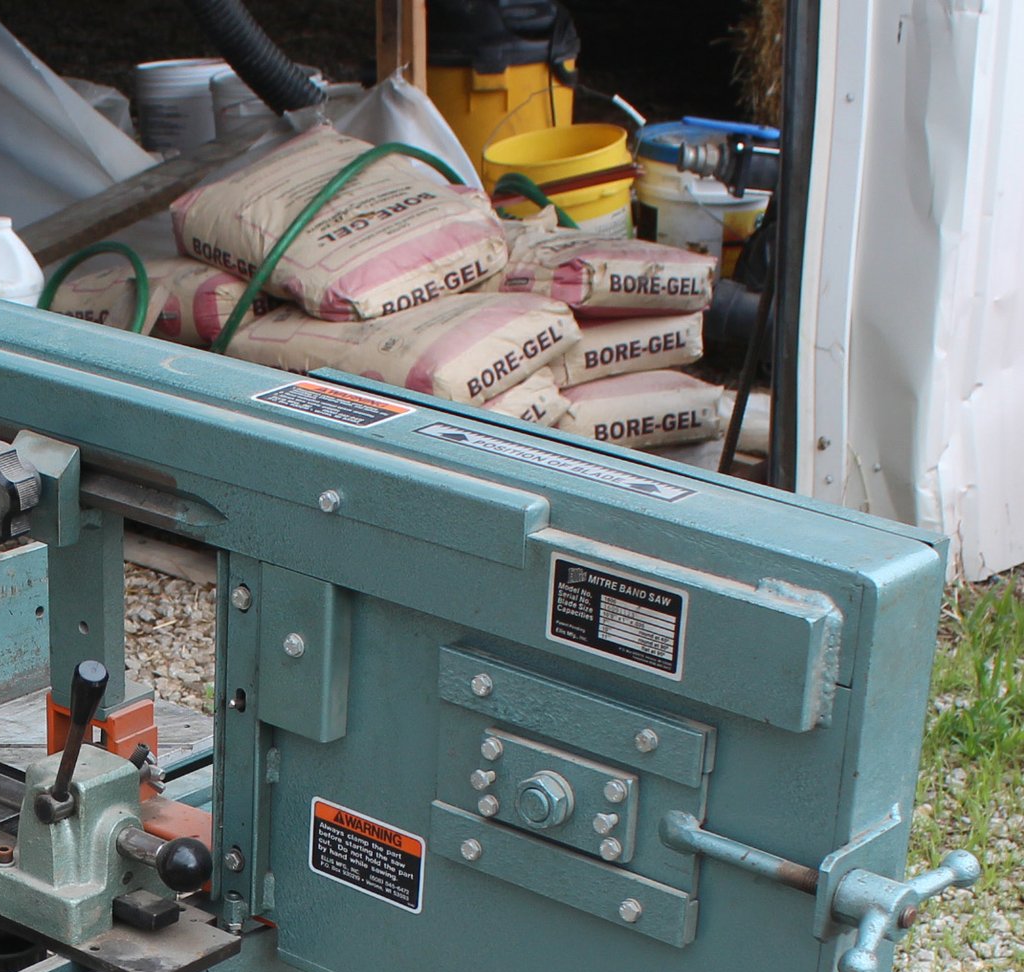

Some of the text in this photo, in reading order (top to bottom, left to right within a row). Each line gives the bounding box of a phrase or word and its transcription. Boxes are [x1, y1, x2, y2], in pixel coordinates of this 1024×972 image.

[382, 257, 489, 316] BORE-GEL
[610, 274, 701, 296] BORE-GEL
[467, 325, 564, 398] BORE-GEL
[584, 331, 687, 370] BORE-GEL
[594, 409, 702, 442] BORE-GEL
[475, 440, 626, 483] POSITION OF BLADE
[557, 597, 578, 608] Blade
[578, 603, 593, 613] Size
[558, 582, 579, 593] Model
[558, 589, 578, 600] Serial
[588, 574, 618, 590] MITRE
[619, 584, 646, 599] BAND
[648, 593, 671, 607] SAW
[556, 604, 594, 621] Capacities
[319, 822, 401, 859] Always clamp the part
[345, 814, 402, 847] WARNING
[318, 829, 405, 868] before starting the saw
[318, 837, 331, 846] cut.
[350, 850, 362, 859] not
[365, 855, 380, 866] hold
[383, 863, 395, 872] the
[398, 869, 414, 880] part
[318, 843, 398, 882] by hand while sawing.
